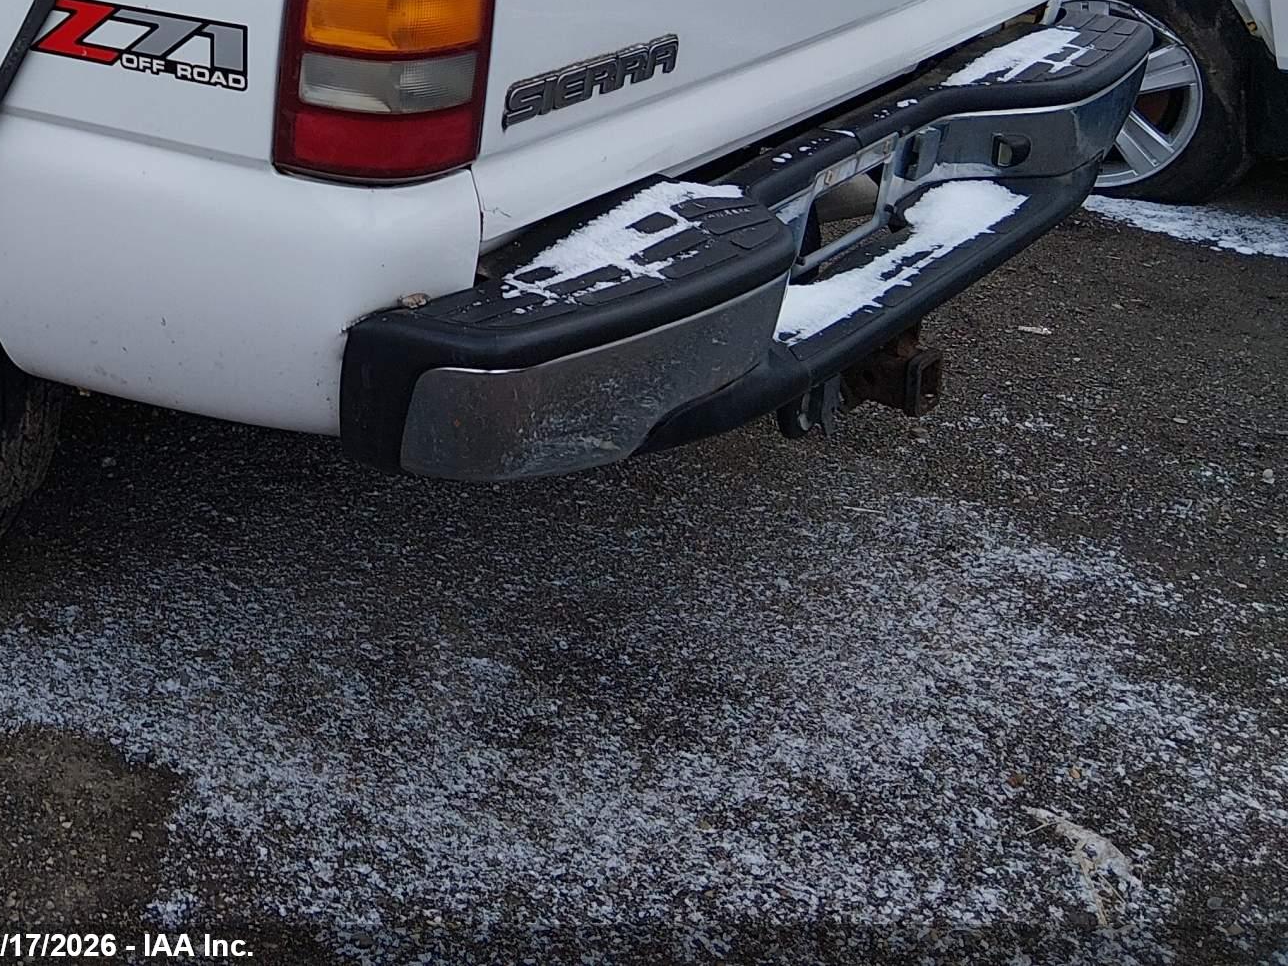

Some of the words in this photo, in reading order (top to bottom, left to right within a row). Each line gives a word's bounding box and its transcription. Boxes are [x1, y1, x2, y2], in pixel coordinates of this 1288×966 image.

[121, 53, 165, 73] OFF
[176, 64, 246, 89] ROAD
[502, 34, 679, 131] SIERRA
